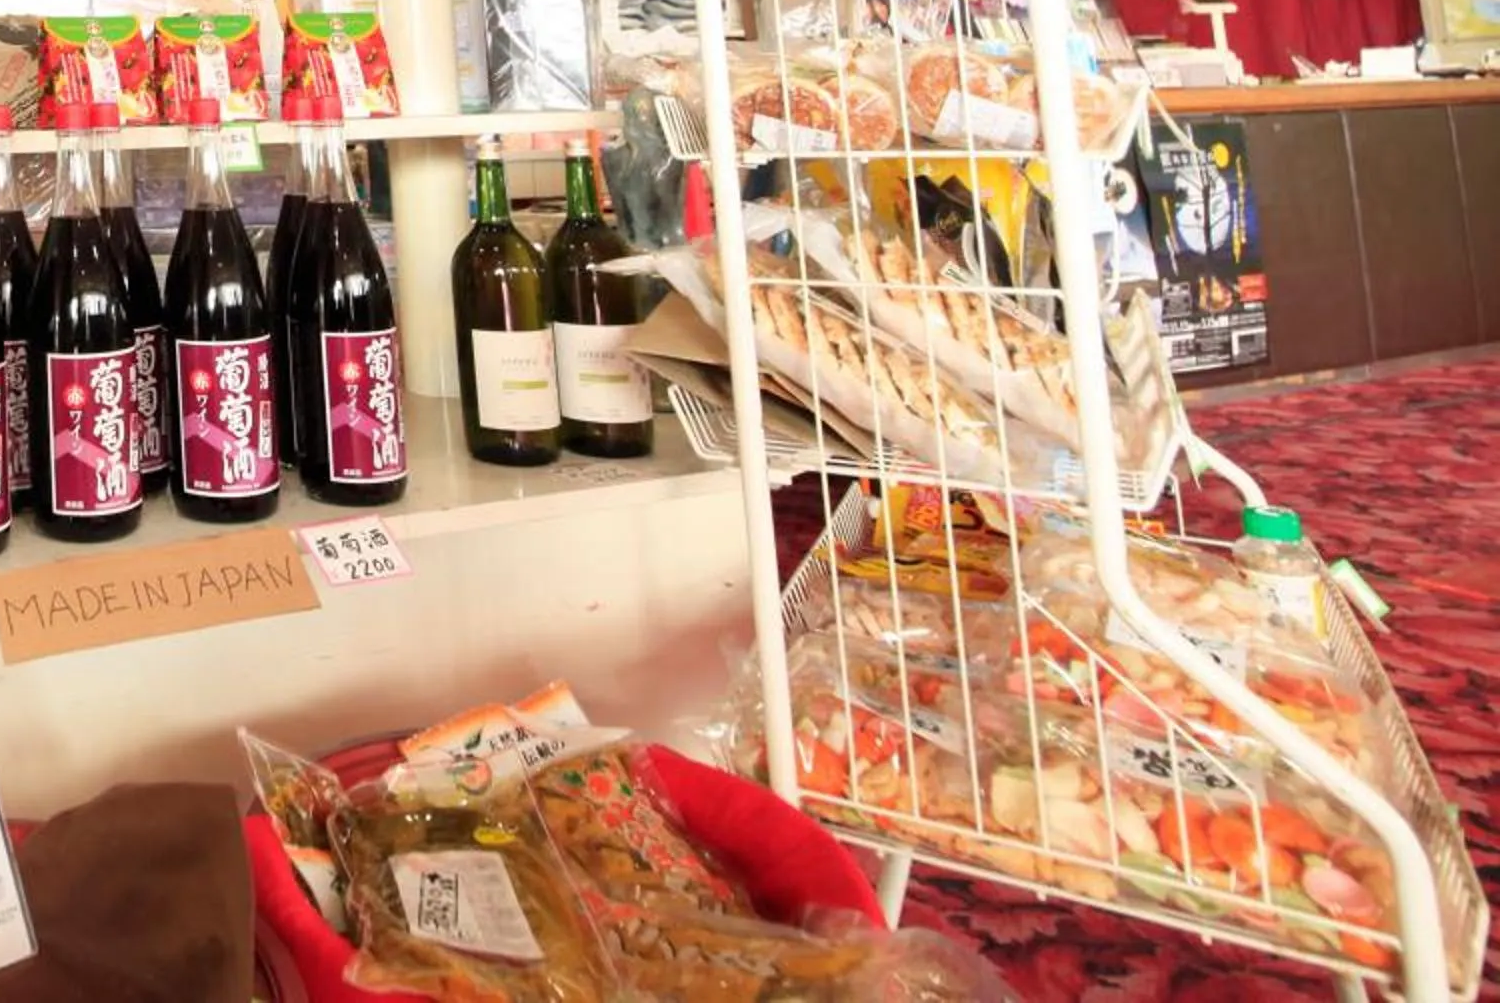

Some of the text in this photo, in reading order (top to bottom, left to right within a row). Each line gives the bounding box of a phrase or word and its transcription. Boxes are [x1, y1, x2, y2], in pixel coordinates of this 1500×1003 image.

[90, 358, 127, 501] 葡萄酒
[215, 346, 256, 483] 葡萄酒
[364, 337, 400, 470] 葡萄酒
[3, 555, 294, 637] MADE IN JAPAN
[344, 557, 395, 580] 2200
